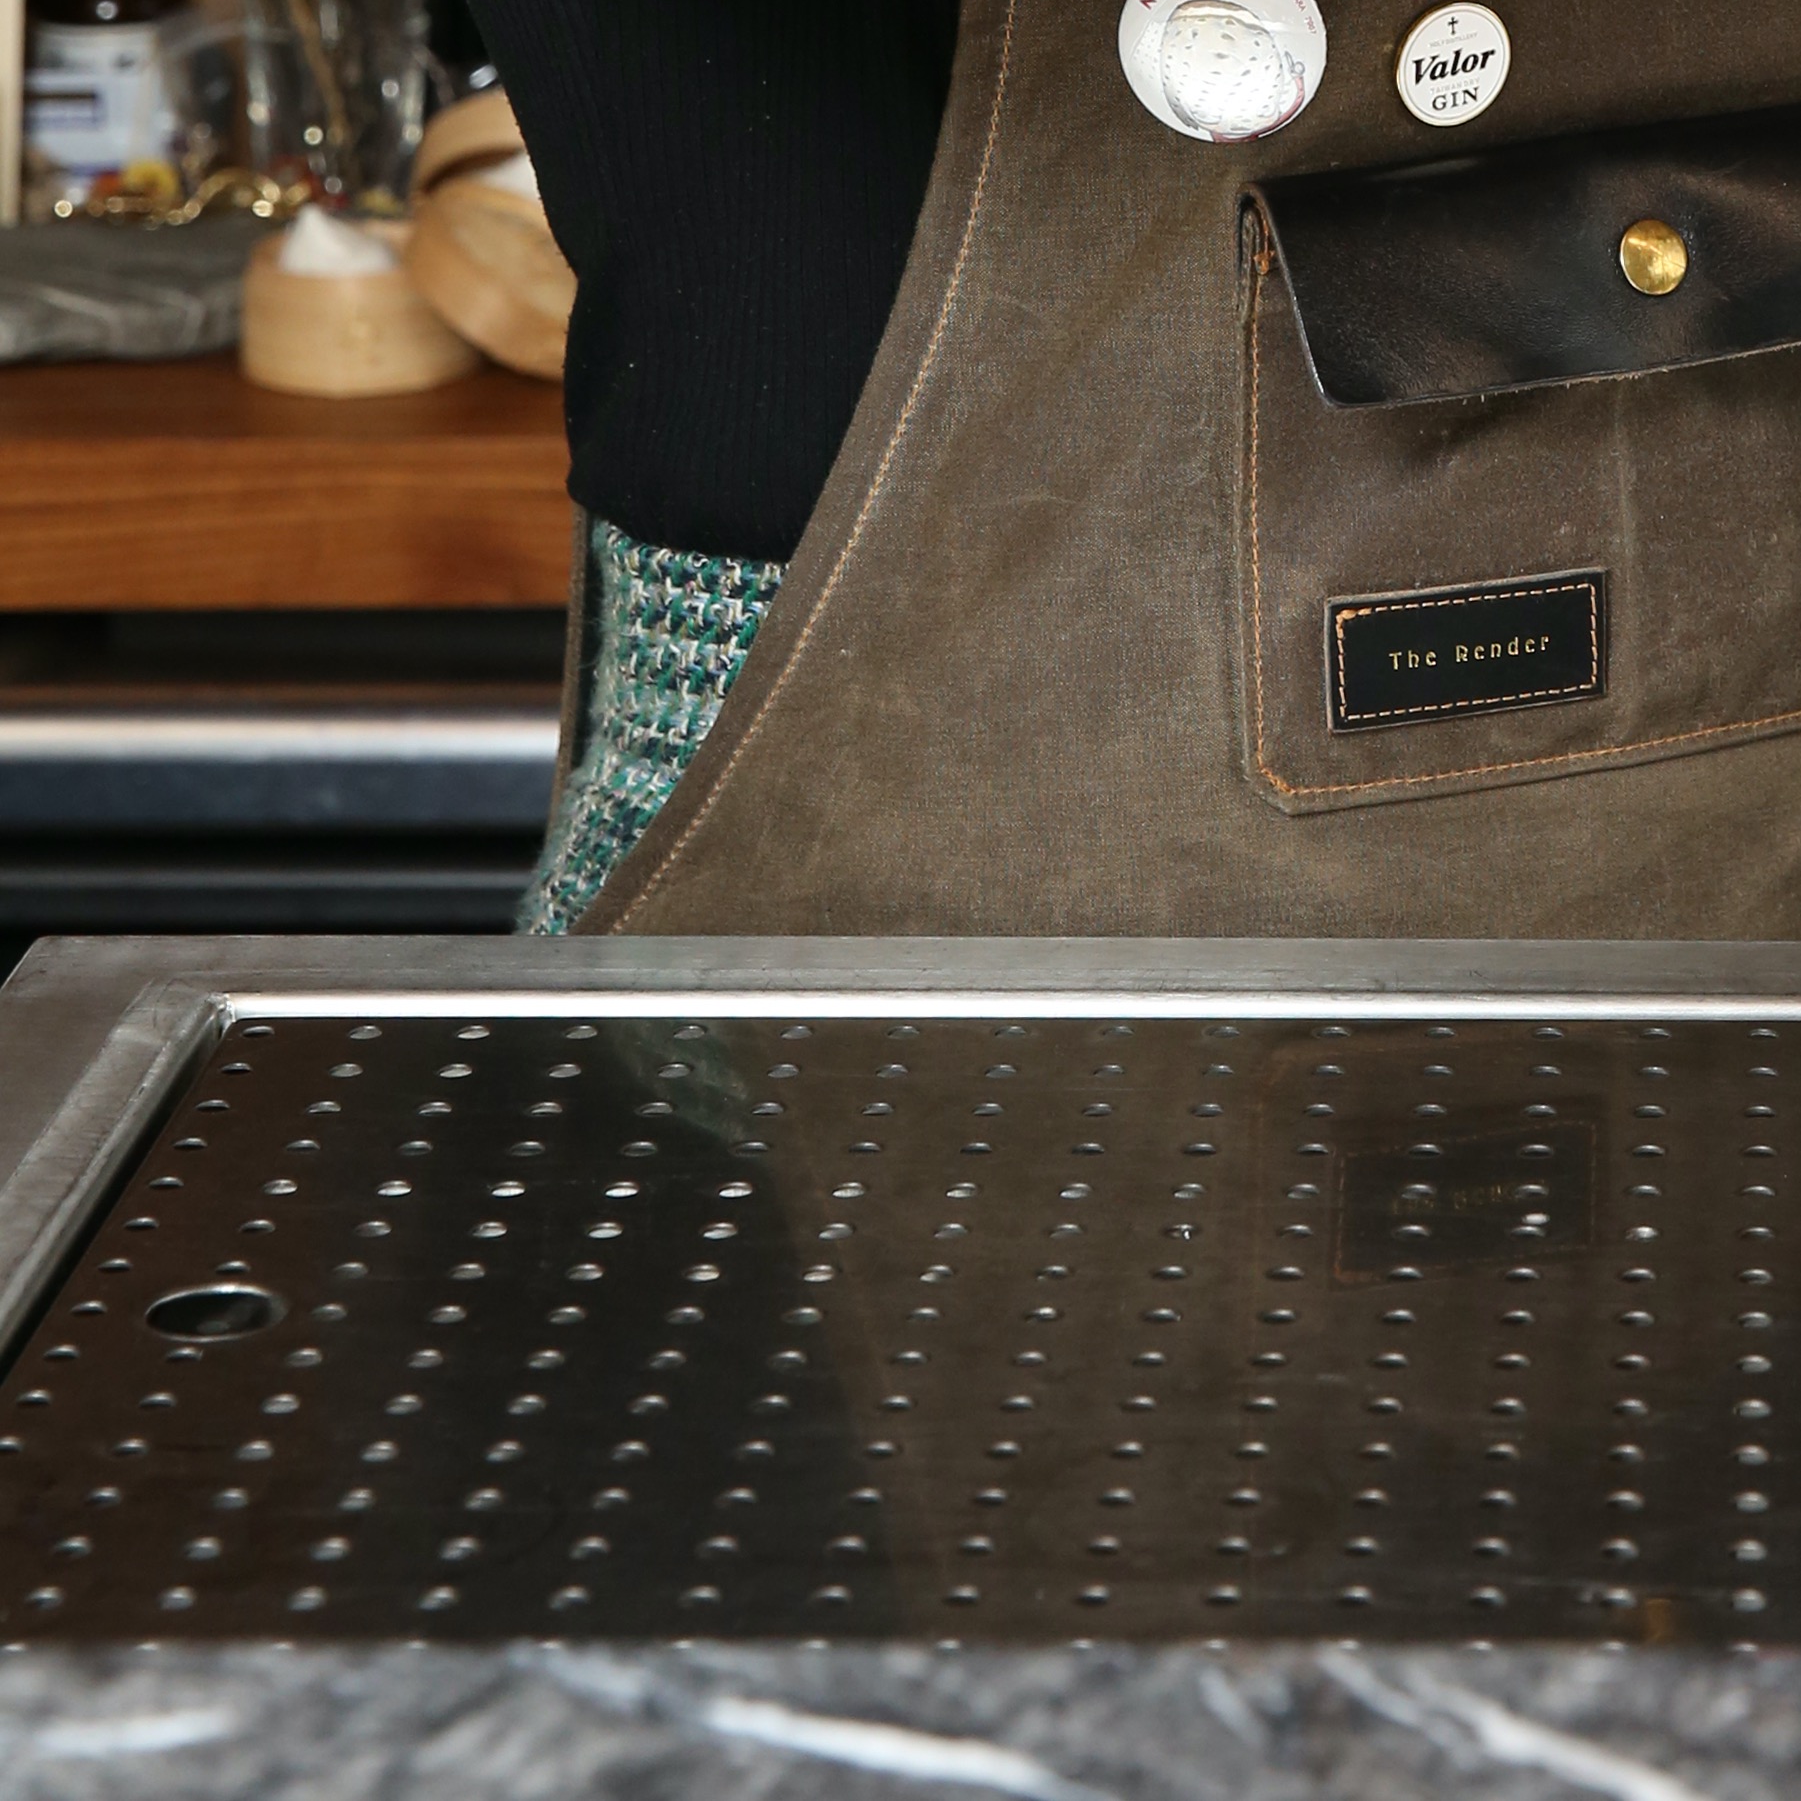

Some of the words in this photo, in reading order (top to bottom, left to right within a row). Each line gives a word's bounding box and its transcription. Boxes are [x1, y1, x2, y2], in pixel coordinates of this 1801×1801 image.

[1412, 48, 1496, 86] Valor
[1432, 86, 1479, 111] GIN
[1389, 650, 1437, 671] The
[1455, 634, 1550, 663] Render
